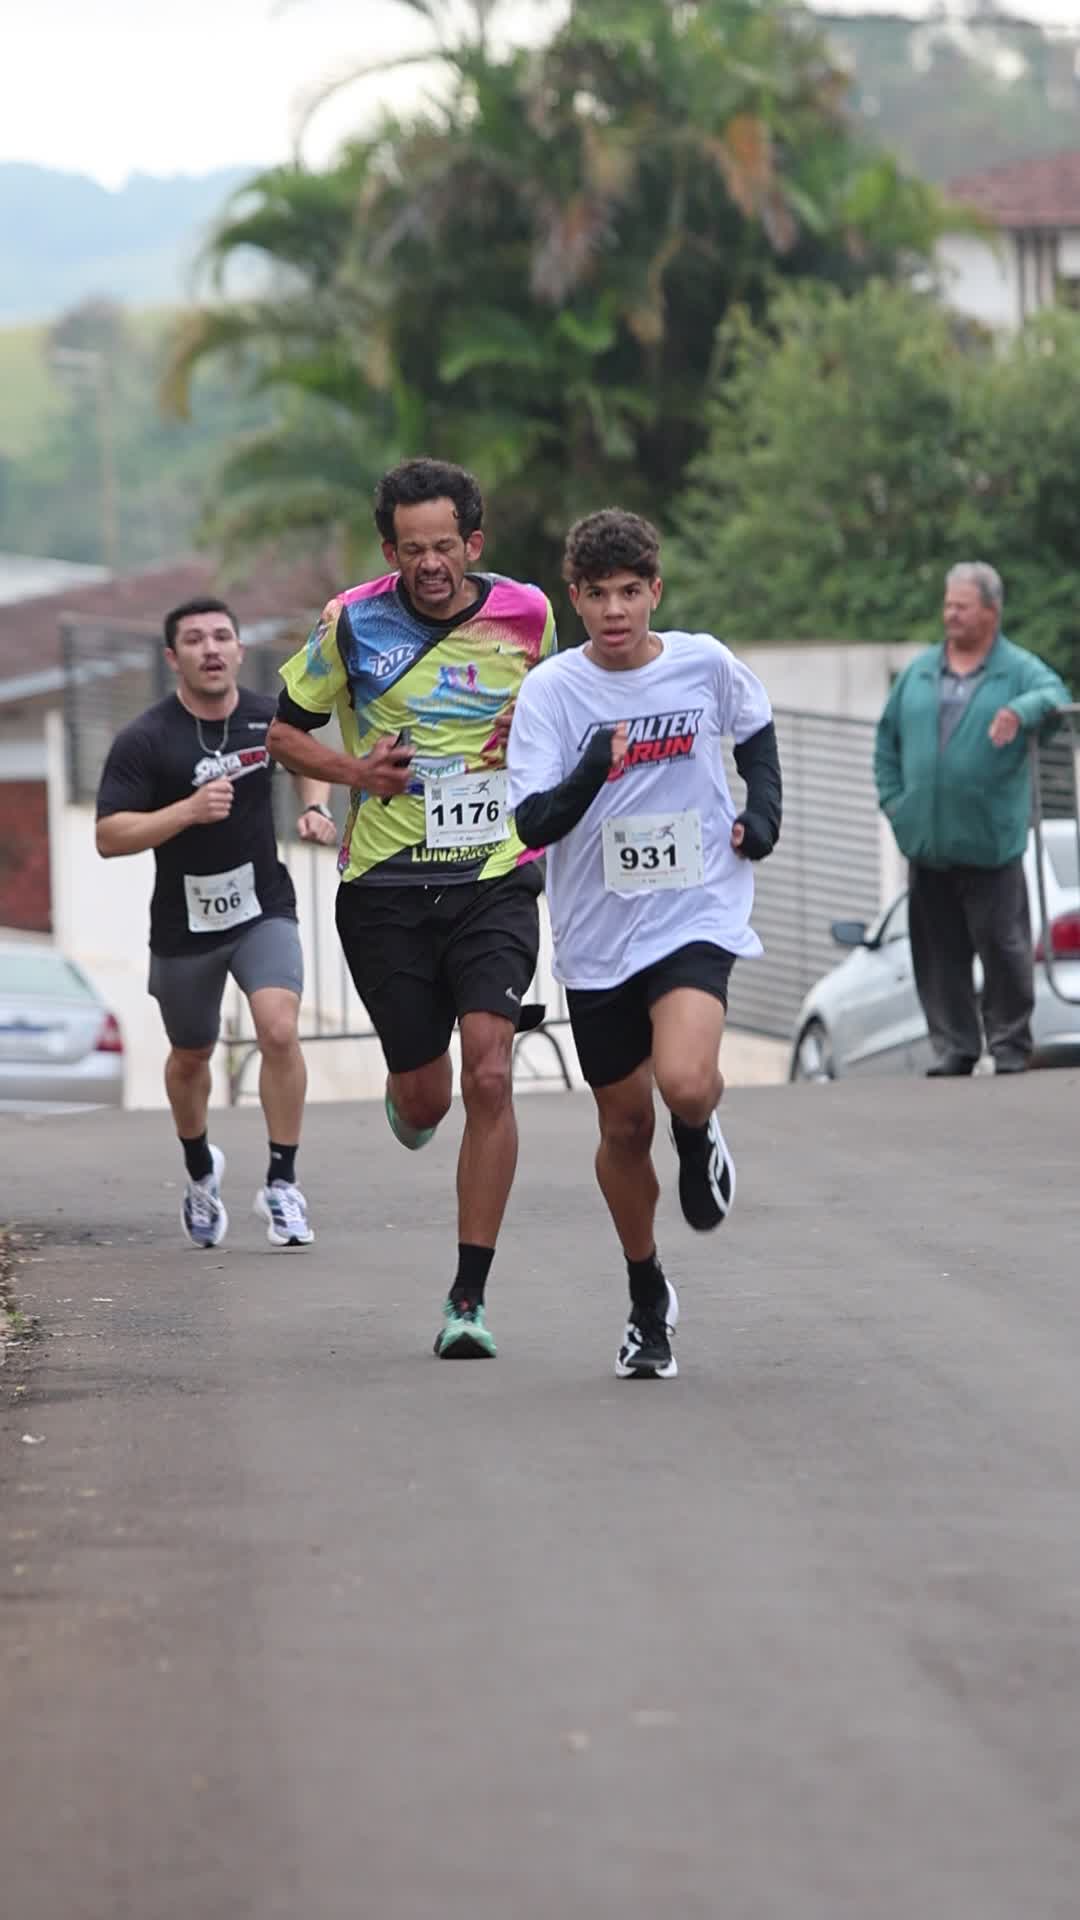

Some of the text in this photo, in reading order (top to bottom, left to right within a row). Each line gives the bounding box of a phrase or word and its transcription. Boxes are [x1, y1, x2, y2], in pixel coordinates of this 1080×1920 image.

[431, 800, 499, 827] 1176
[620, 844, 677, 870] 931
[199, 892, 241, 915] 706
